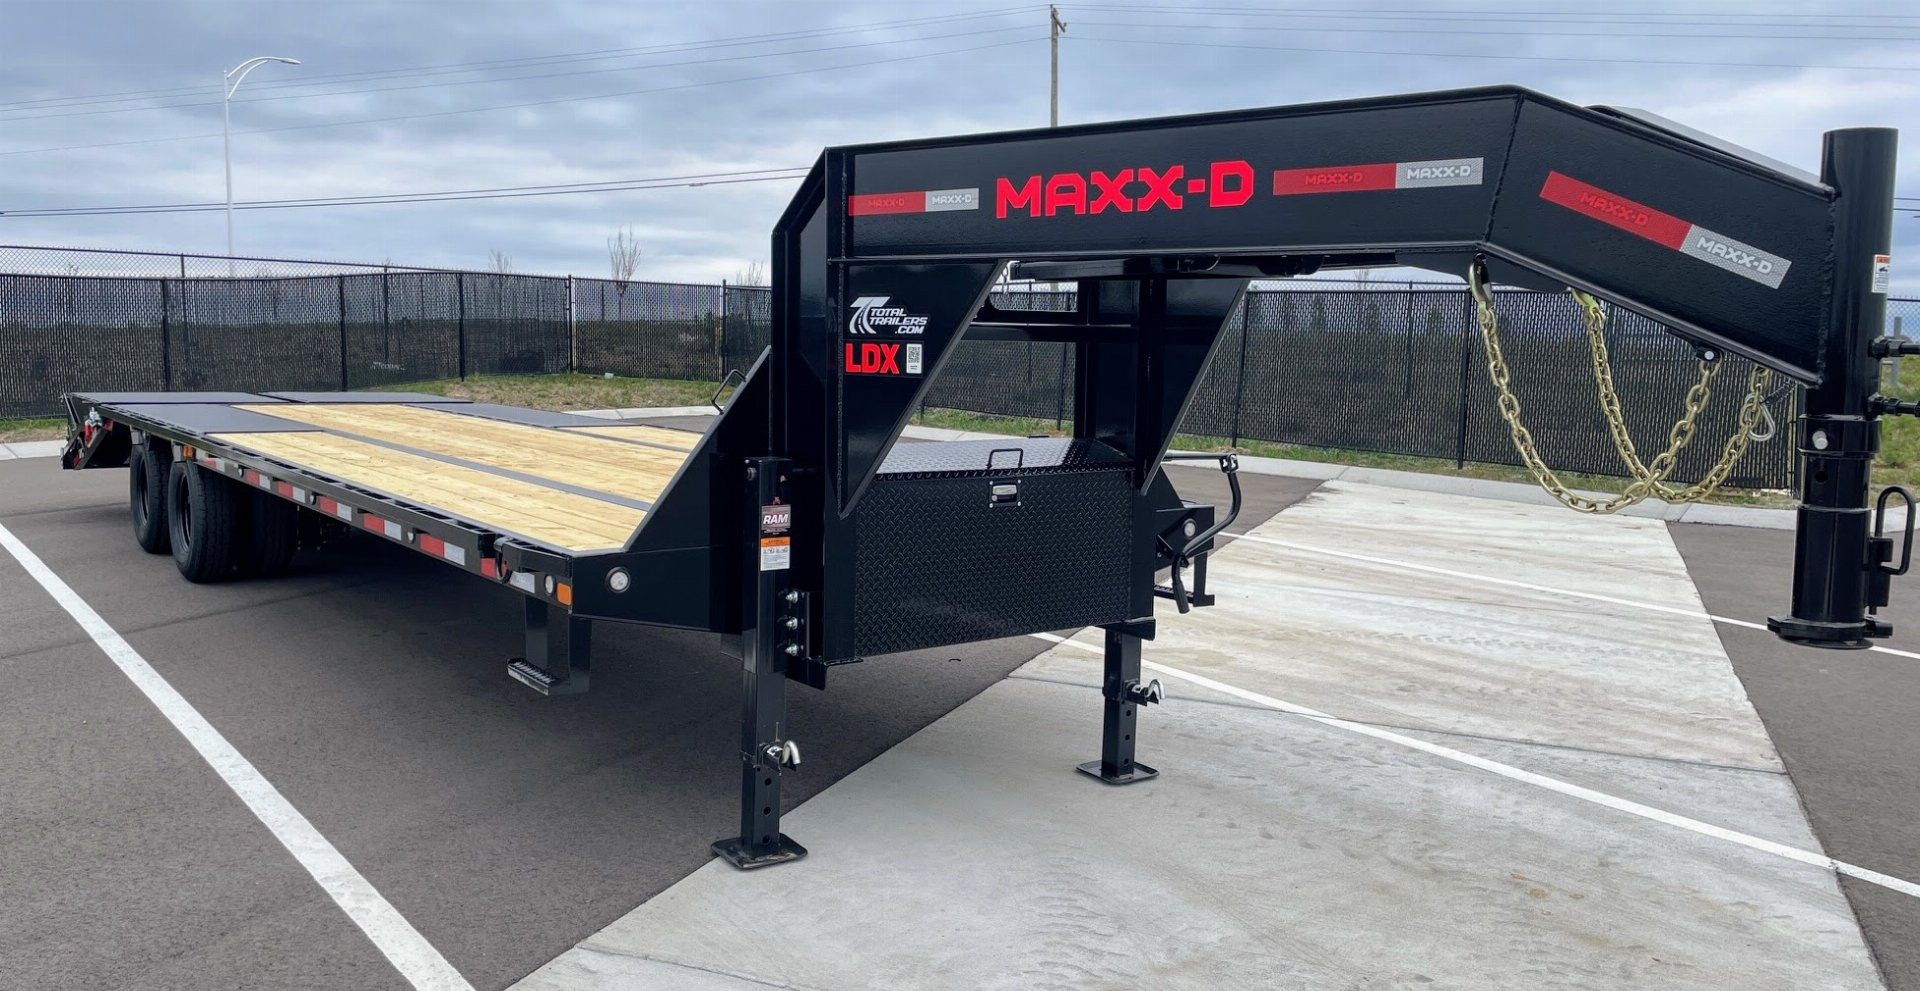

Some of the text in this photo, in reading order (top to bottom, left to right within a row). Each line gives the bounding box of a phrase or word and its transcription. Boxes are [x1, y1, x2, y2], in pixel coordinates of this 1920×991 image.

[1304, 172, 1363, 185] MAXX-D
[1407, 165, 1471, 180] MAXX-D
[996, 160, 1254, 219] MAXX-D
[932, 194, 972, 205] MAXX-D
[1579, 191, 1649, 227] MAXX-D
[1696, 236, 1773, 275] MAXX-D
[870, 308, 907, 316] TOTAL
[869, 317, 928, 325] TRAILERS
[894, 326, 925, 334] .COM
[845, 343, 900, 374] LDX
[763, 514, 788, 525] RAM
